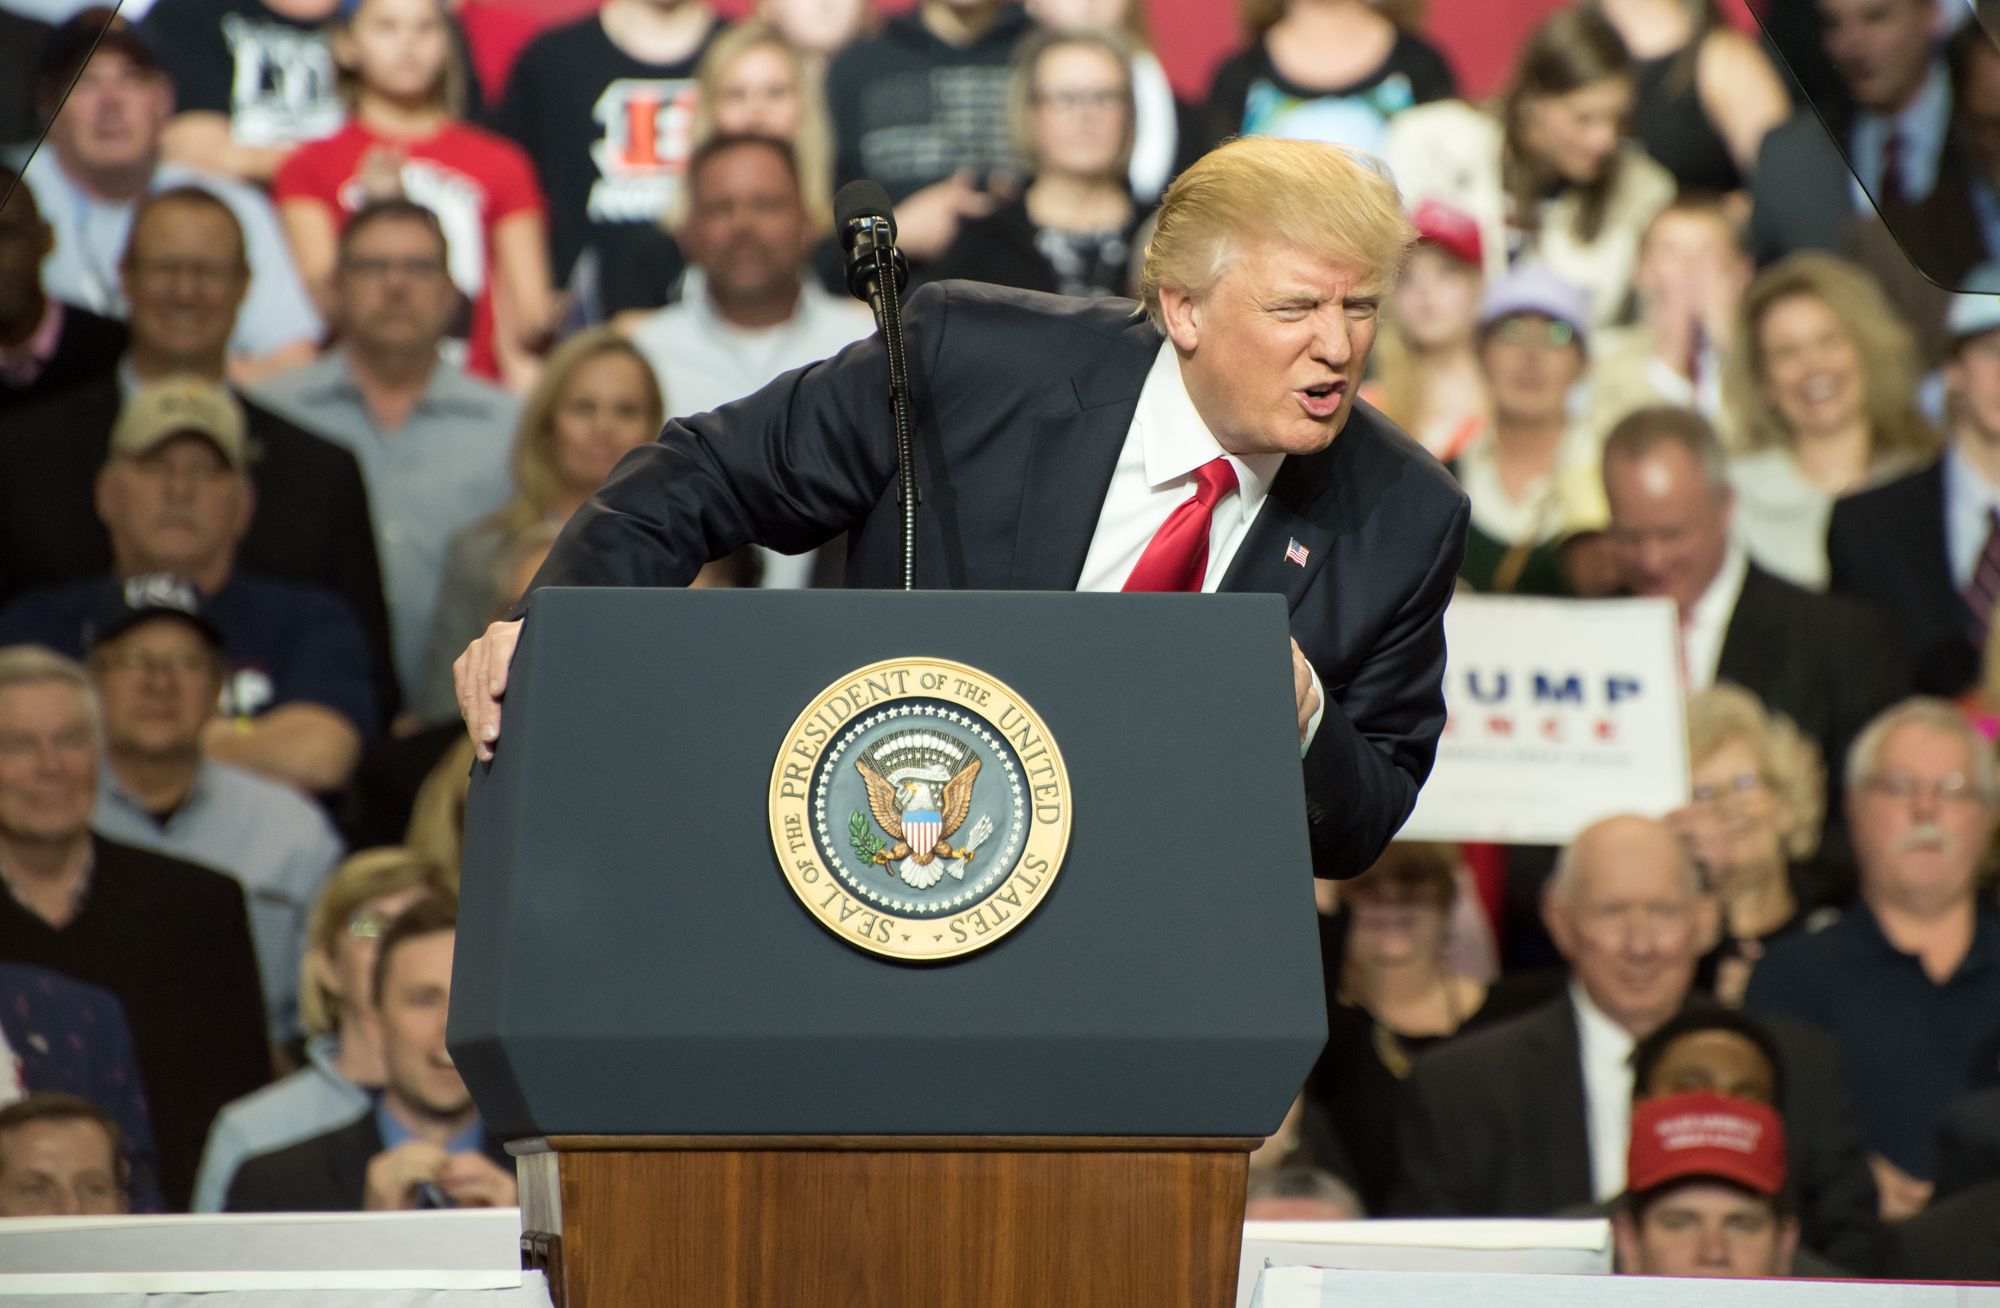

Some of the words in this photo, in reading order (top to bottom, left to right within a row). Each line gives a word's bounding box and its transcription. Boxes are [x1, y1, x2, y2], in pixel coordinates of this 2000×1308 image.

[920, 672, 947, 690] OF
[954, 678, 990, 707] THE
[1443, 668, 1643, 706] UMP
[780, 669, 910, 800] PRESIDENT
[998, 704, 1060, 825] UNITED
[784, 813, 806, 854] THE
[796, 859, 819, 883] OF
[820, 883, 894, 943] SEAL
[949, 853, 1048, 944] STATES
